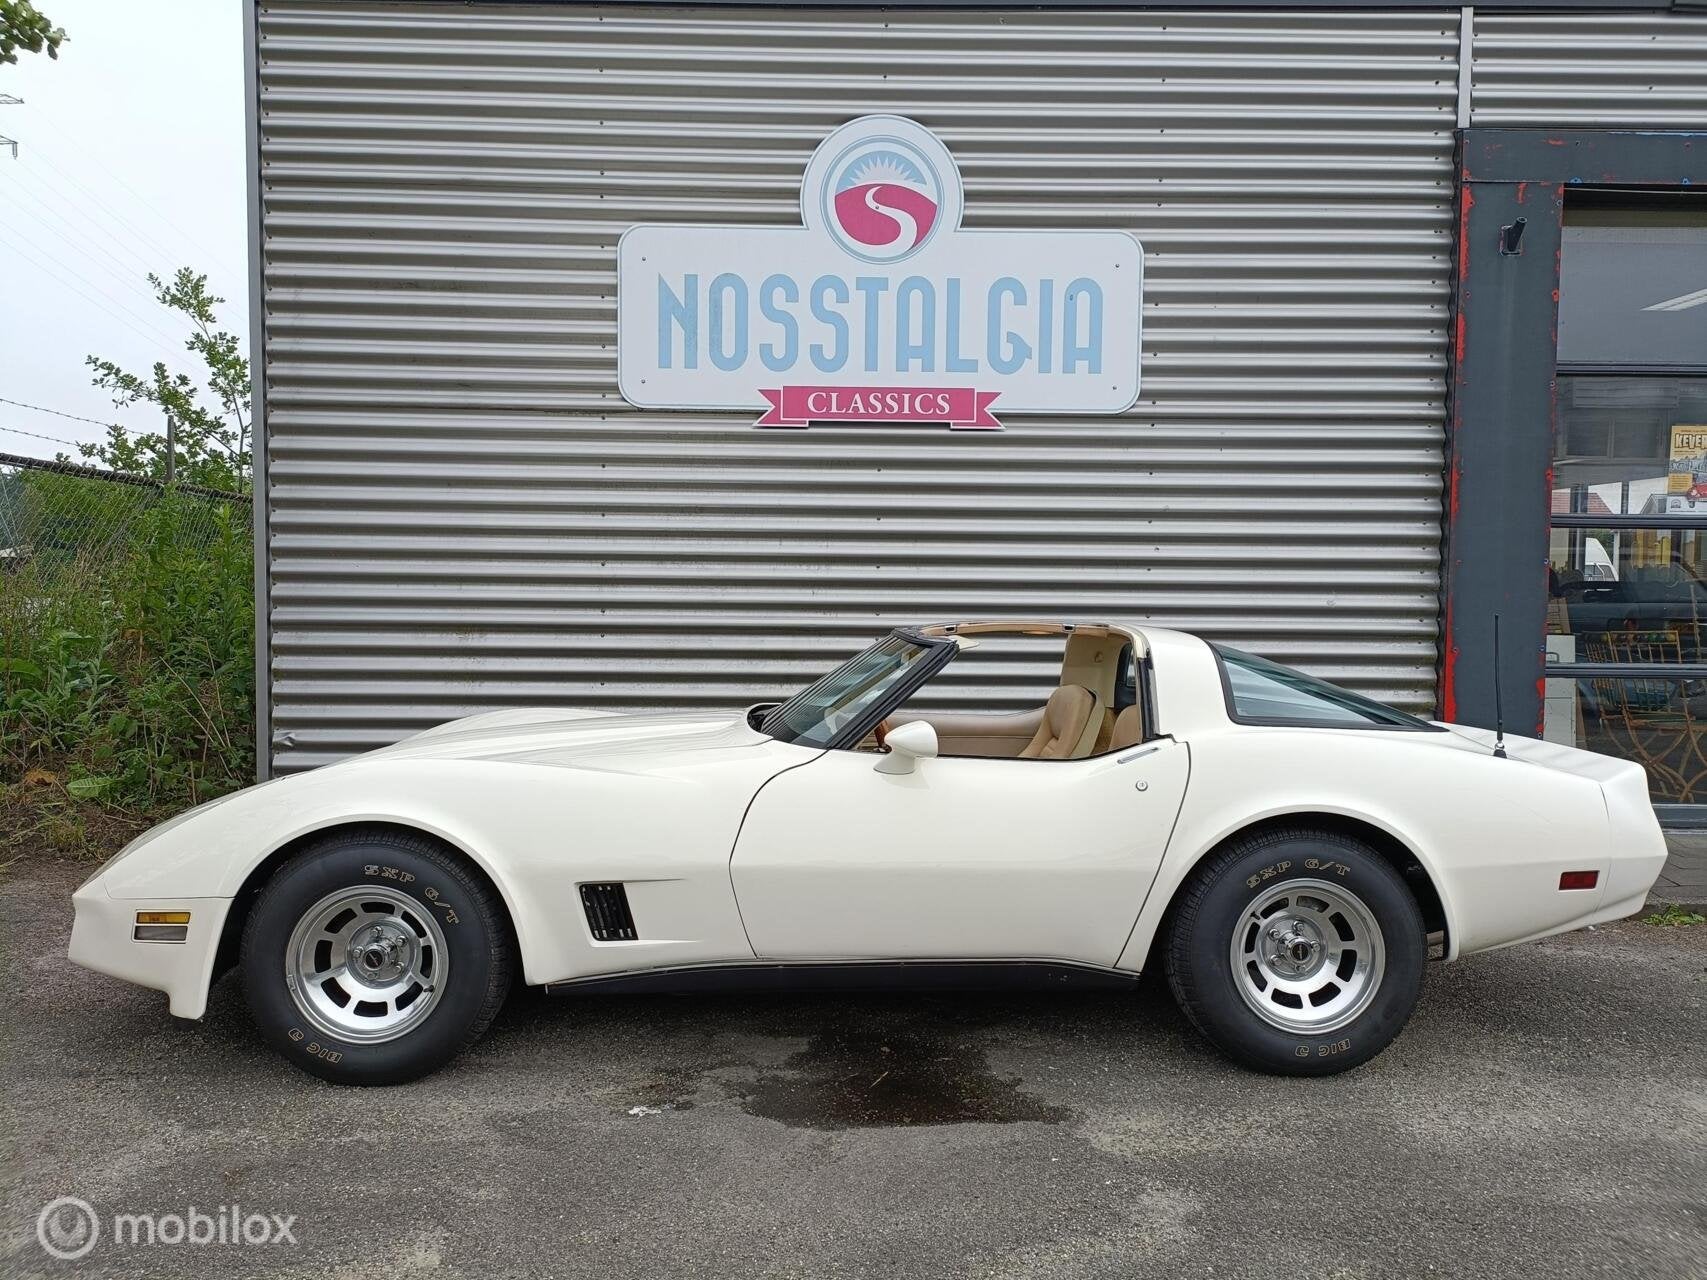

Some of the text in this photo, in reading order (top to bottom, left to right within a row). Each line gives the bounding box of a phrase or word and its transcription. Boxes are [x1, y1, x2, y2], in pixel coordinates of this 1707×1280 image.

[658, 272, 1104, 375] NOSSTALGIA
[807, 391, 950, 414] CLASSICS
[1246, 858, 1351, 889] SXP G/T
[364, 864, 460, 924] SXP G/T
[306, 1042, 343, 1064] BIG
[1318, 1038, 1351, 1057] BIG
